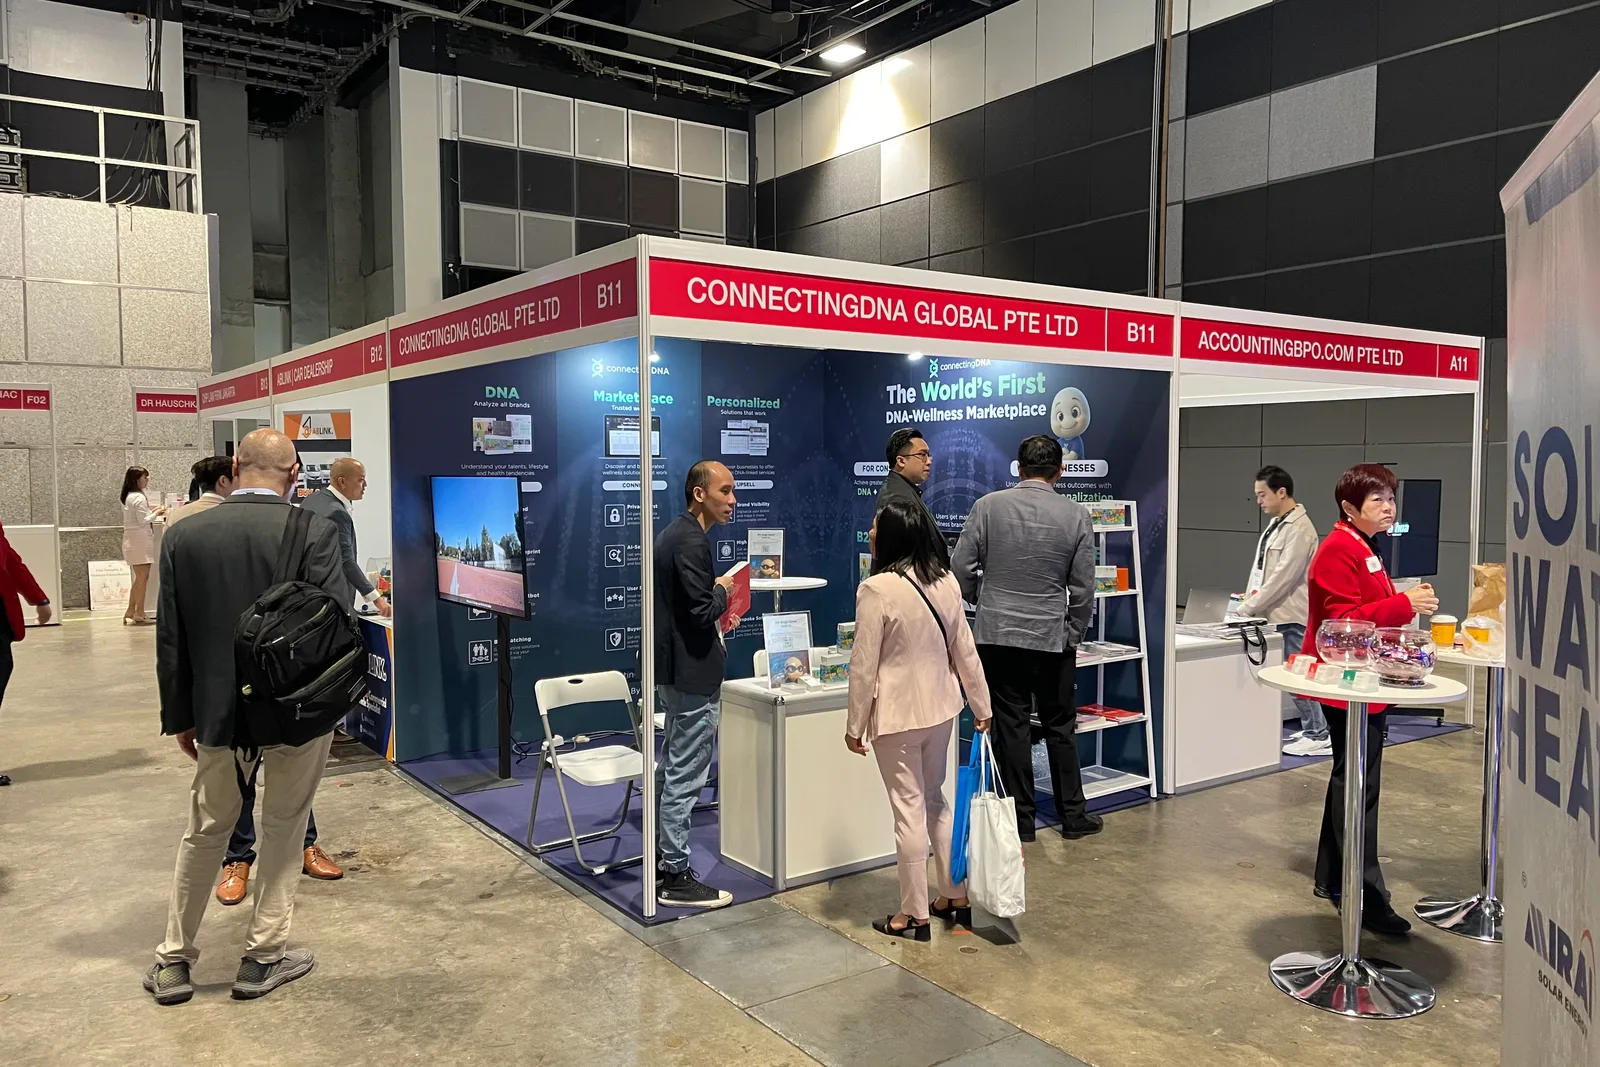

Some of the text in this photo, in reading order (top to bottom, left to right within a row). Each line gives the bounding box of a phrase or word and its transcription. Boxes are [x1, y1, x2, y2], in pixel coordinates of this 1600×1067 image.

[596, 279, 622, 309] B11
[687, 276, 1078, 337] CONNECTINGDNA GLOBAL PTE LTD
[399, 296, 560, 355] CONNECTINGDNA GLOBAL PTE LTD
[1126, 321, 1156, 344] B11
[370, 344, 383, 364] B12
[1198, 330, 1404, 366] ACCOUNTINGBPO.COM PTE LTD
[276, 369, 292, 387] ABLINK
[293, 365, 304, 383] CAR
[303, 358, 333, 380] DEALERSHIP
[940, 358, 992, 371] connectingDNA
[1449, 355, 1469, 372] A11
[485, 386, 519, 399] DNA
[593, 389, 674, 405] Marketace
[886, 383, 916, 405] The
[998, 371, 1046, 397] First
[26, 395, 47, 404] F02
[141, 398, 198, 408] DR HAUSCHK
[473, 400, 499, 409] Analyze
[707, 395, 781, 409] Personalized
[885, 402, 1047, 424] DNA-Wellness Marketplace
[857, 487, 871, 496] DNA
[1513, 425, 1600, 548] SOL
[1507, 665, 1600, 845] HEA
[1538, 969, 1563, 1006] SOLAR
